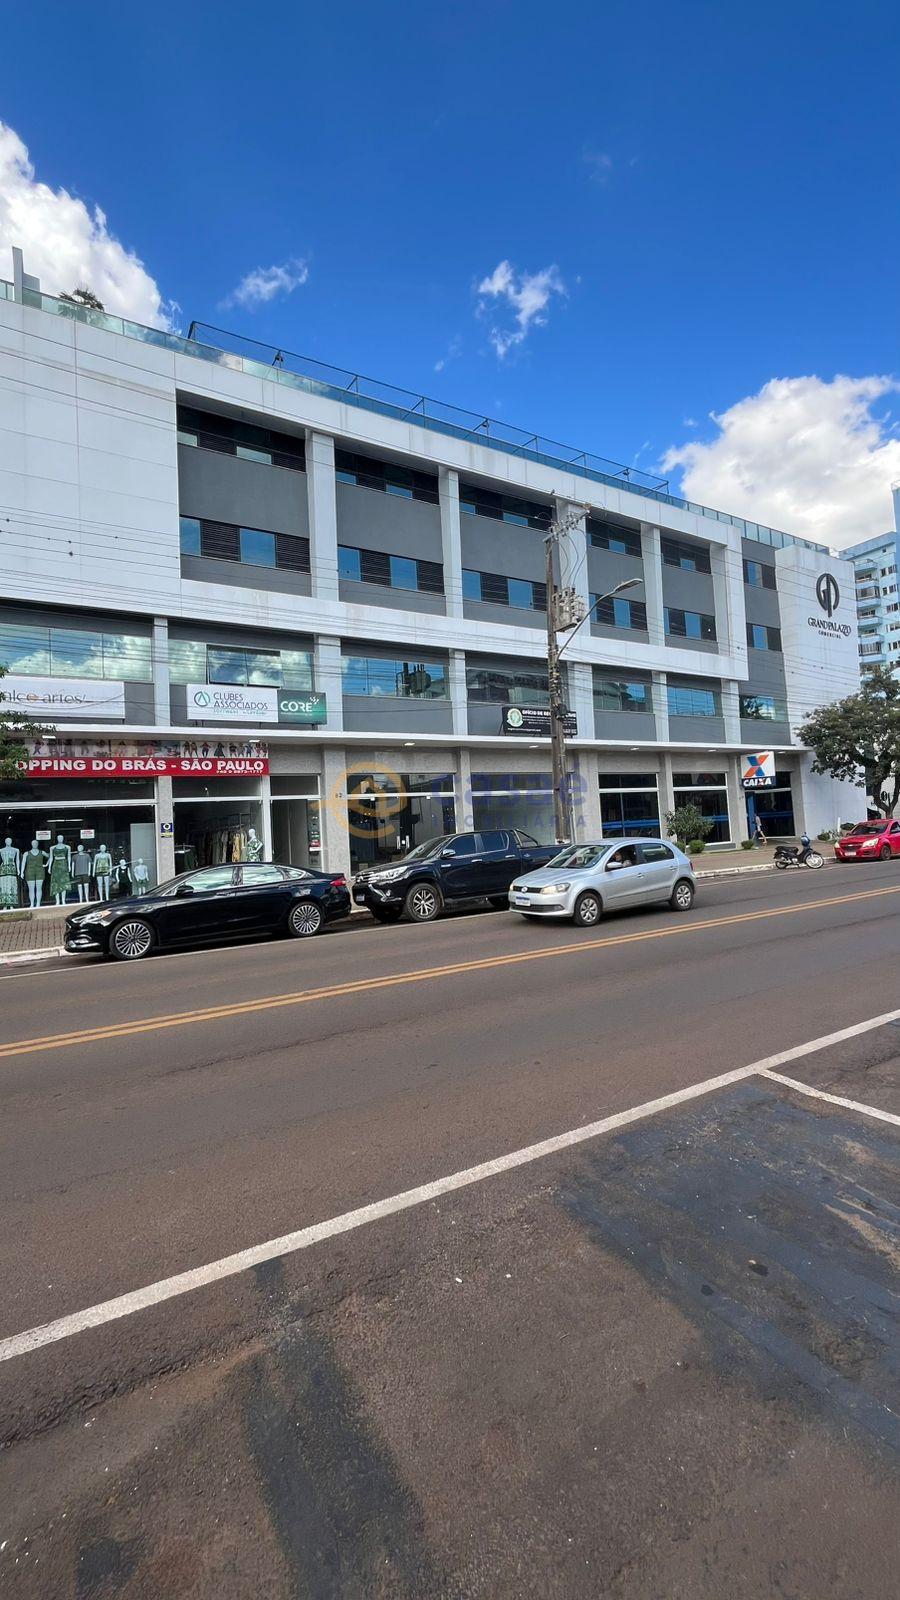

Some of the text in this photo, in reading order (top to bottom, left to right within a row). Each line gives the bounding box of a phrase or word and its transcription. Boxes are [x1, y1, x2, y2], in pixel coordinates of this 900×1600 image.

[213, 692, 244, 701] CLUBES
[213, 701, 269, 711] ASSOCIADOS
[280, 700, 313, 712] CORE
[15, 759, 86, 771] OPPING
[92, 760, 117, 771] DO
[122, 758, 167, 771] BRÁS
[181, 758, 213, 771] SÃO
[217, 760, 265, 771] PAULO
[743, 777, 772, 787] CAIXA
